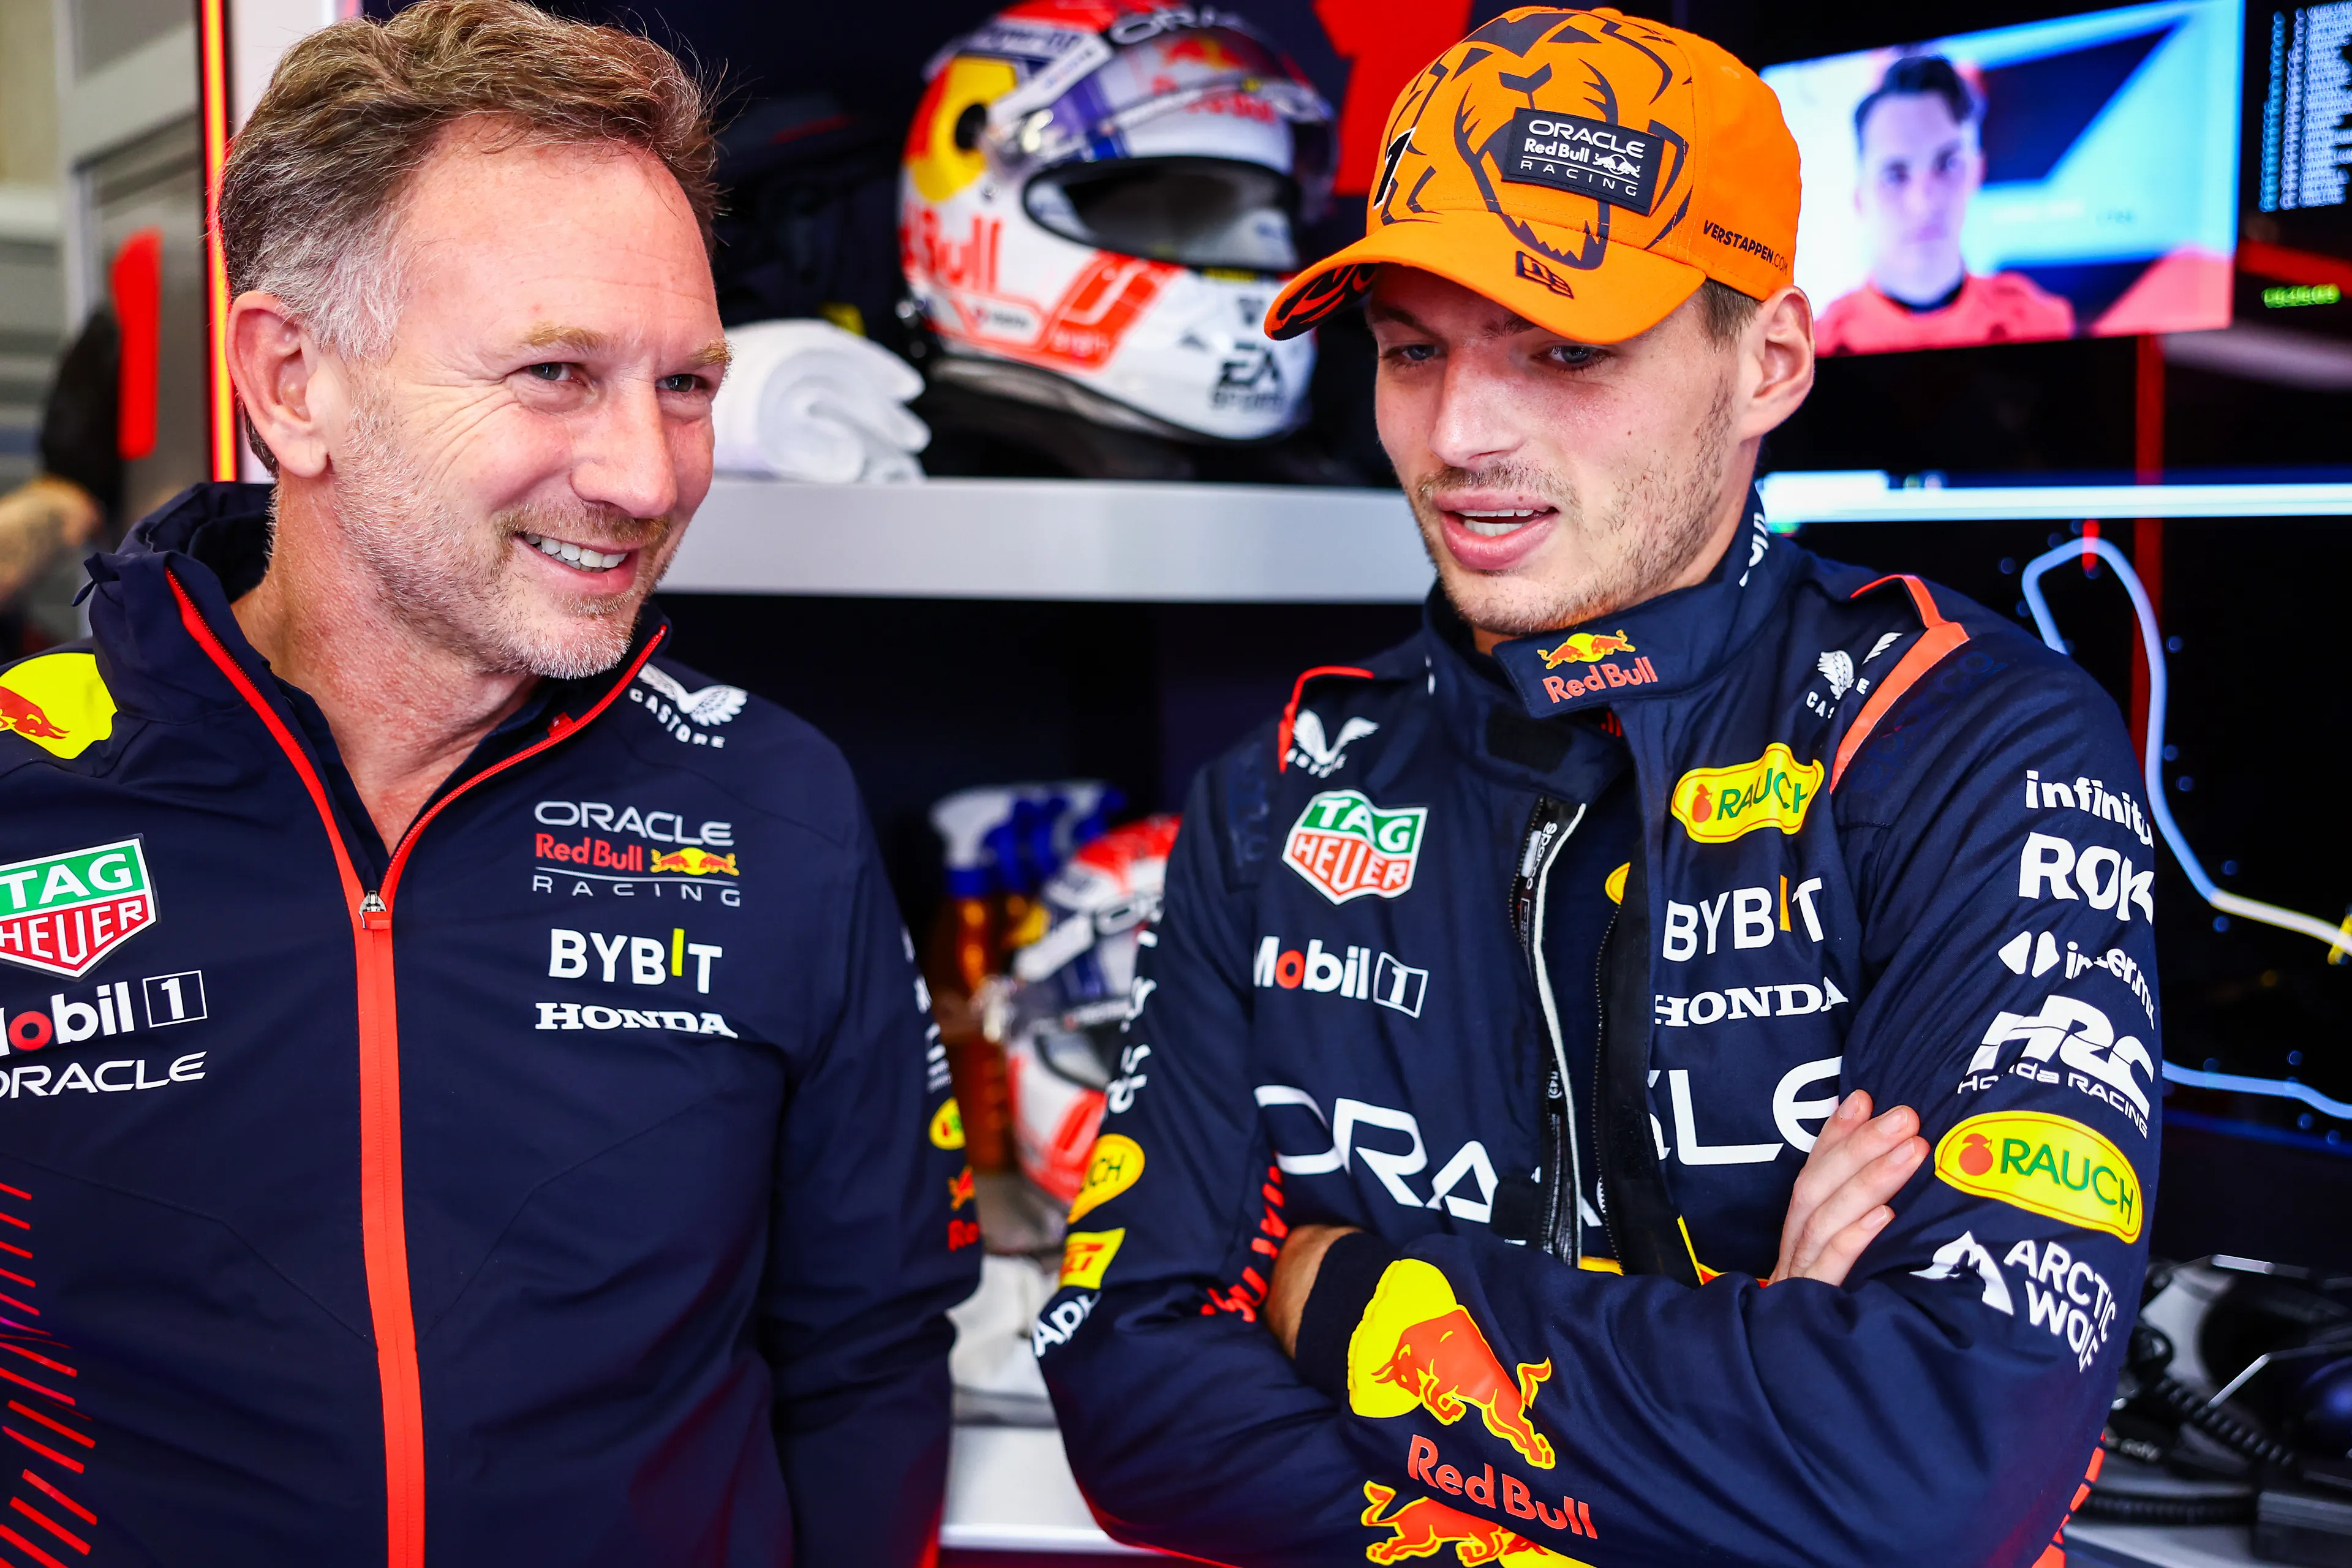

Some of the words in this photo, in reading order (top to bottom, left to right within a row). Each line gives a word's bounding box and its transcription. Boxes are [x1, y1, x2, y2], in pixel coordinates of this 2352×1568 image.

[1524, 138, 1558, 156] Red
[1558, 143, 1590, 163] Bull
[1529, 119, 1646, 159] ORACLE
[1373, 126, 1417, 211] 1
[1520, 160, 1638, 197] RACING
[1703, 219, 1789, 276] VERSTAPPEN.COM
[1542, 664, 1607, 703] Red
[1600, 656, 1659, 688] Bull
[630, 687, 726, 749] CASTORE
[1717, 767, 1808, 821] RAUCH
[534, 801, 735, 846] ORACLE
[1317, 798, 1412, 853] TAG
[535, 833, 591, 864] Red
[592, 839, 644, 872] Bull
[1294, 835, 1408, 892] HEUER
[0, 853, 134, 910] TAG
[532, 874, 741, 907] RACING
[0, 899, 143, 965] HEUER
[1662, 874, 1824, 962] BYBIT
[548, 928, 723, 993] BYBIT
[1389, 965, 1408, 1005] 1
[160, 978, 185, 1020] 1
[535, 1002, 739, 1038] HONDA
[1654, 976, 1849, 1027] HONDA
[0, 1050, 208, 1099] RACLE
[2067, 1072, 2148, 1139] RACING
[2000, 1138, 2134, 1225] RAUCH
[2003, 1240, 2117, 1343] ARCTIC
[2025, 1280, 2099, 1373] WOLF
[1408, 1434, 1496, 1509] Red
[1502, 1473, 1597, 1539] Bull
